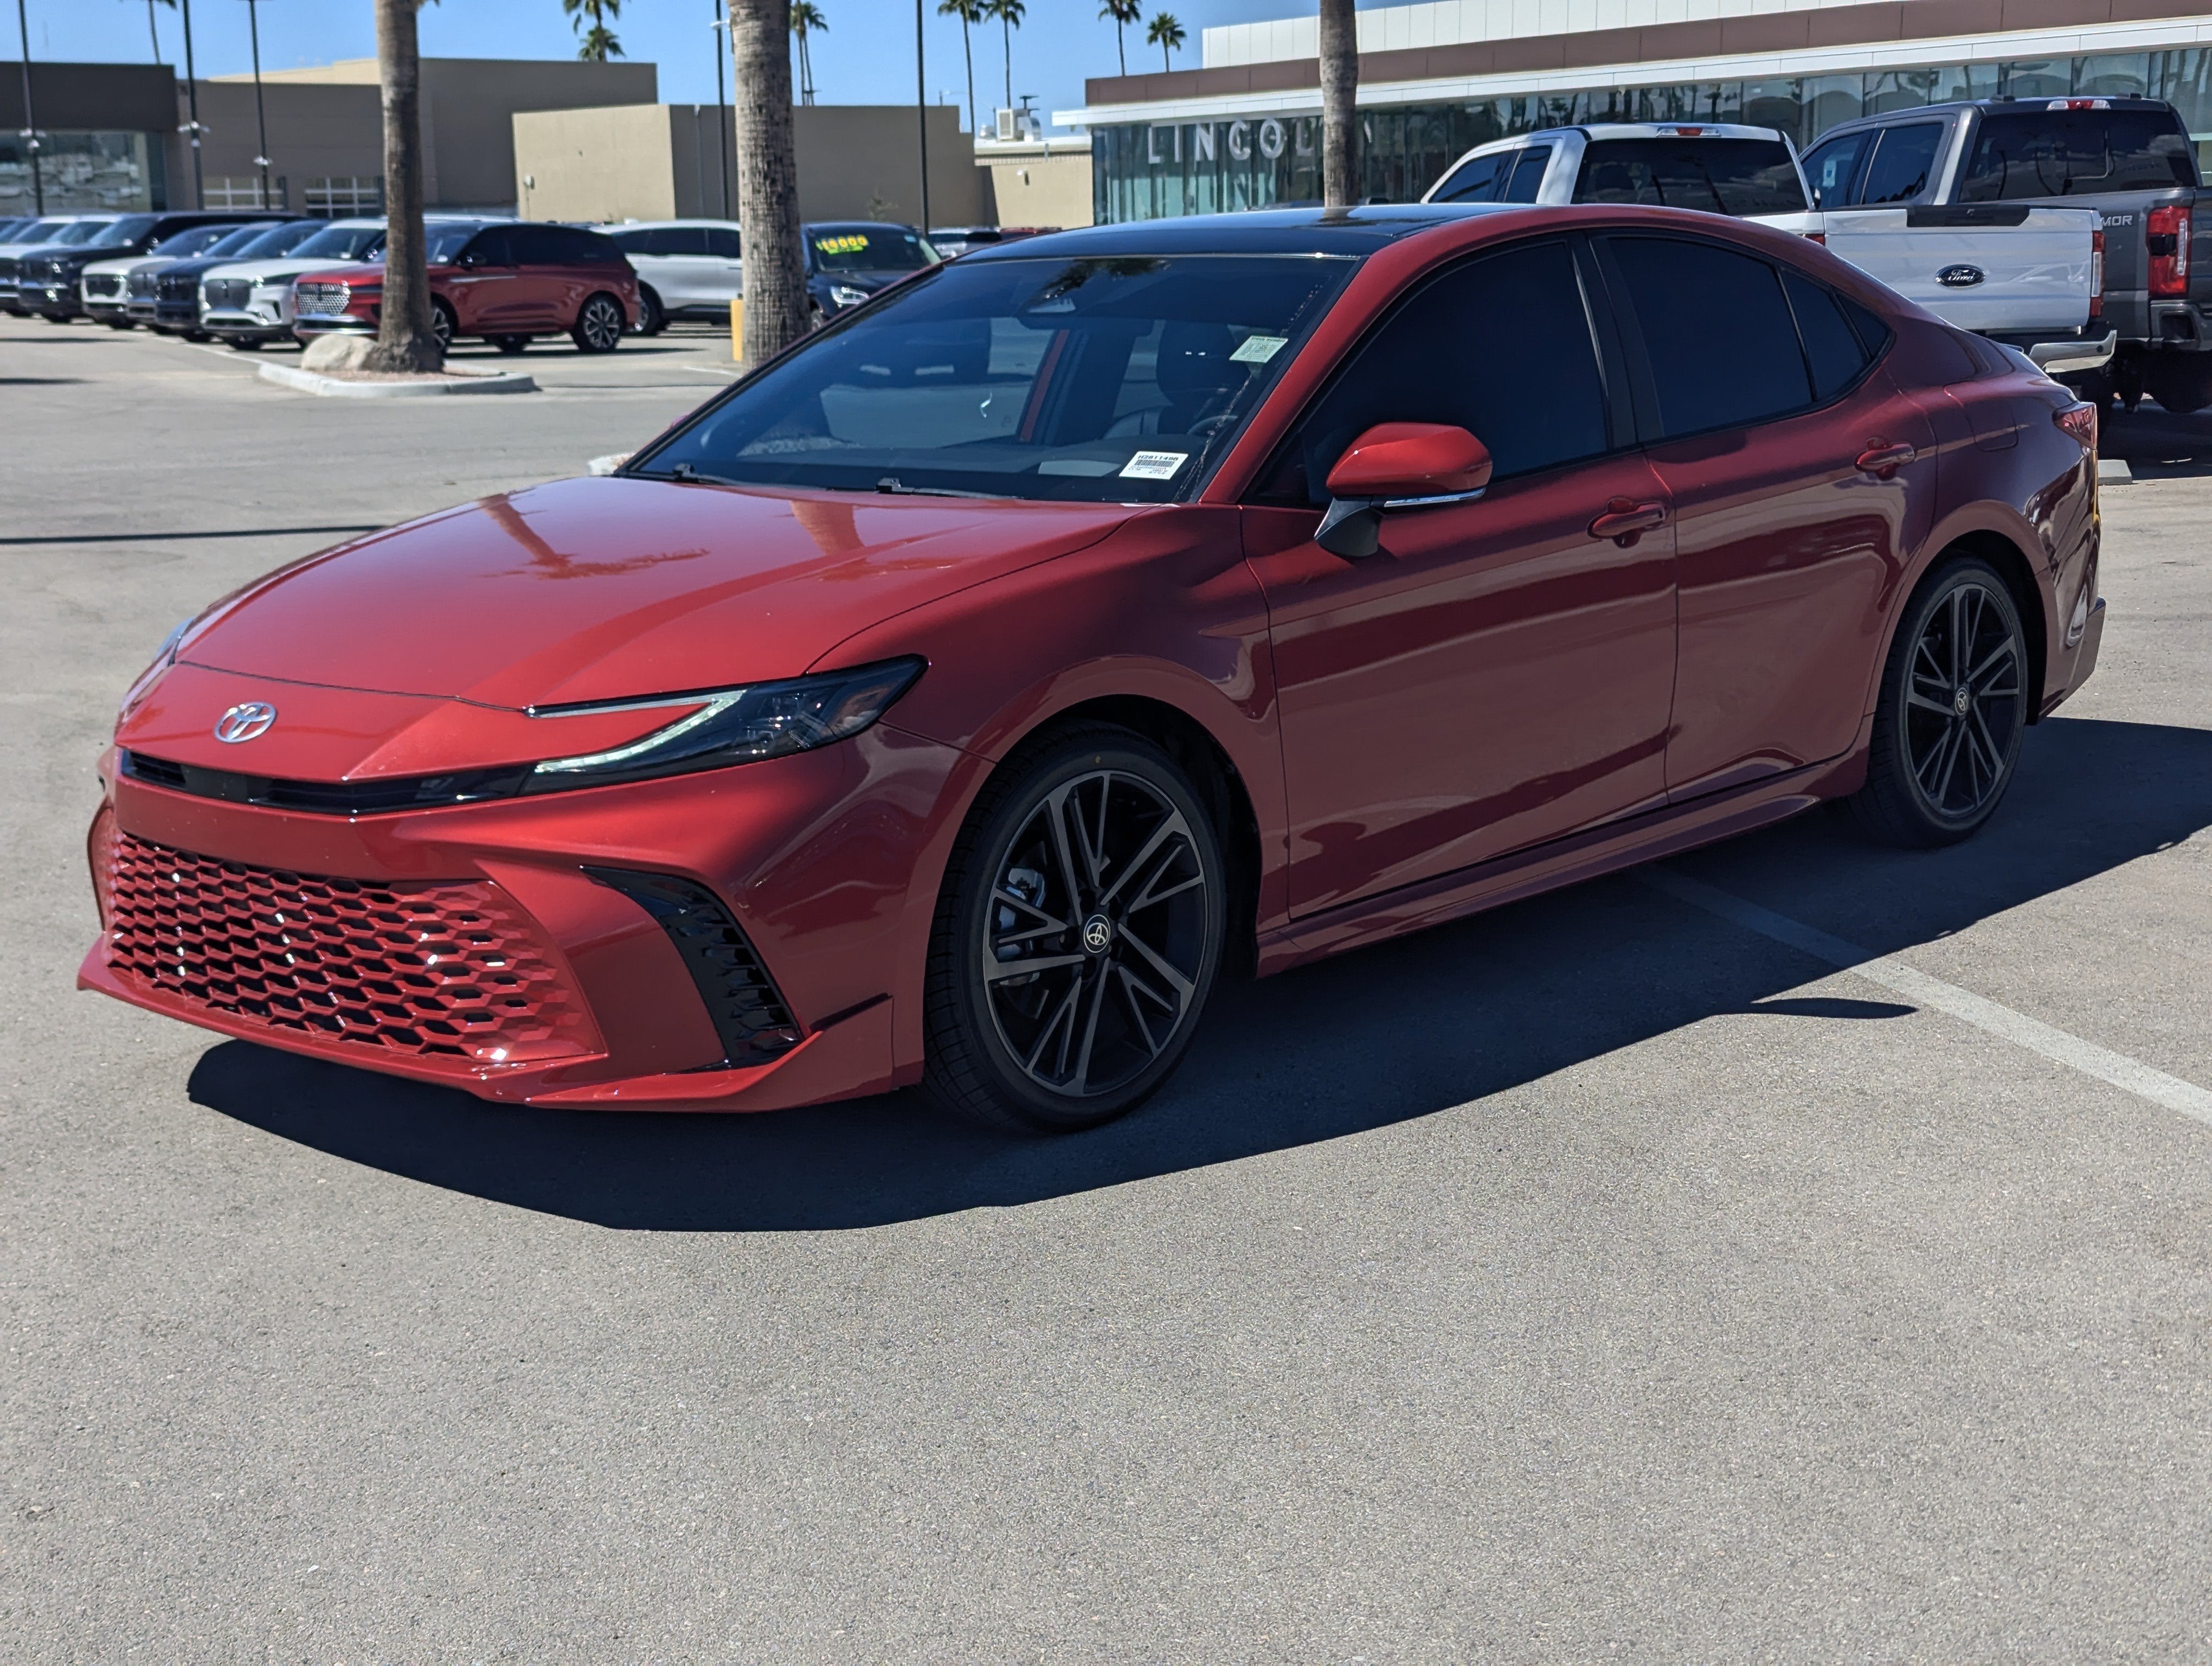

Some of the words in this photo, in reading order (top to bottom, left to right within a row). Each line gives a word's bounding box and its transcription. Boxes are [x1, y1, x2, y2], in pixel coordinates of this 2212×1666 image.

[1148, 118, 1315, 164] LINCOL
[2100, 215, 2133, 227] MOR
[1947, 268, 1976, 282] Ford
